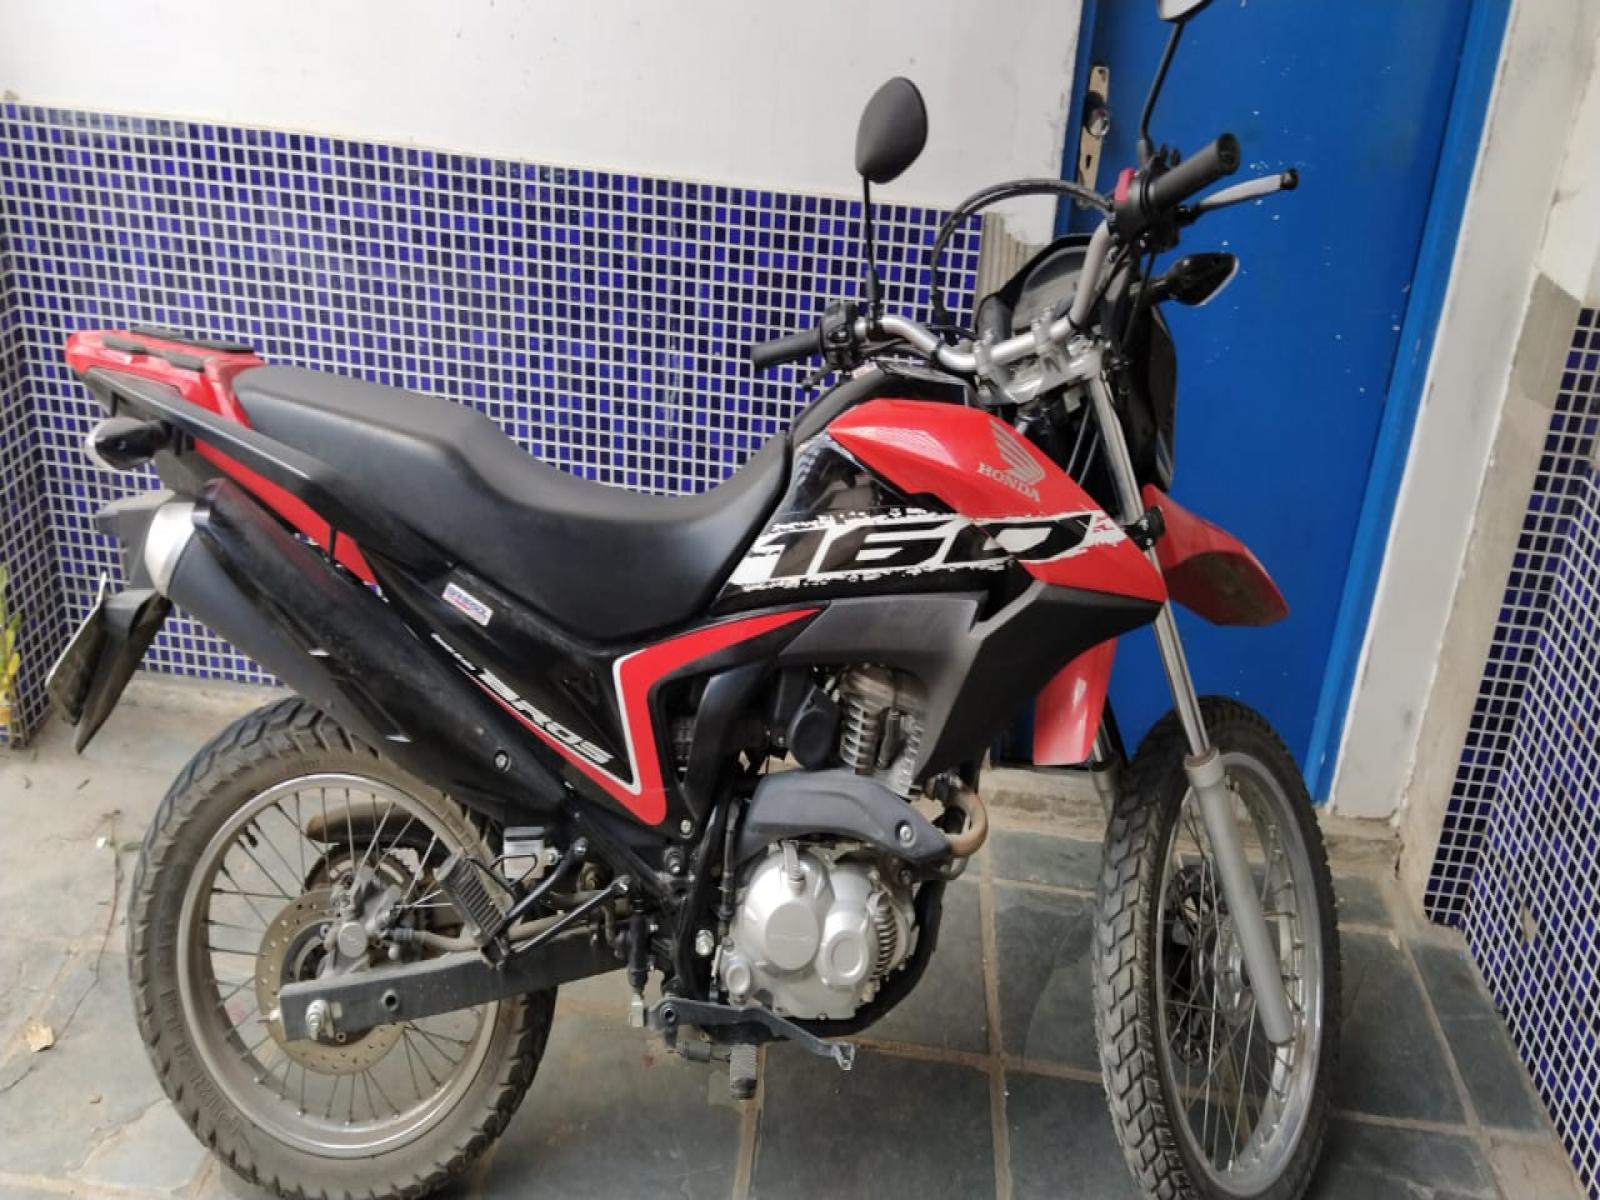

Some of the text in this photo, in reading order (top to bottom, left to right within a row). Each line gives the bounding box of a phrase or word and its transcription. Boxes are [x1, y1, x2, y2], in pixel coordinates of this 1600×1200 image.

[977, 461, 1040, 502] HONDA
[754, 513, 1093, 580] 160
[478, 667, 614, 764] BROS
